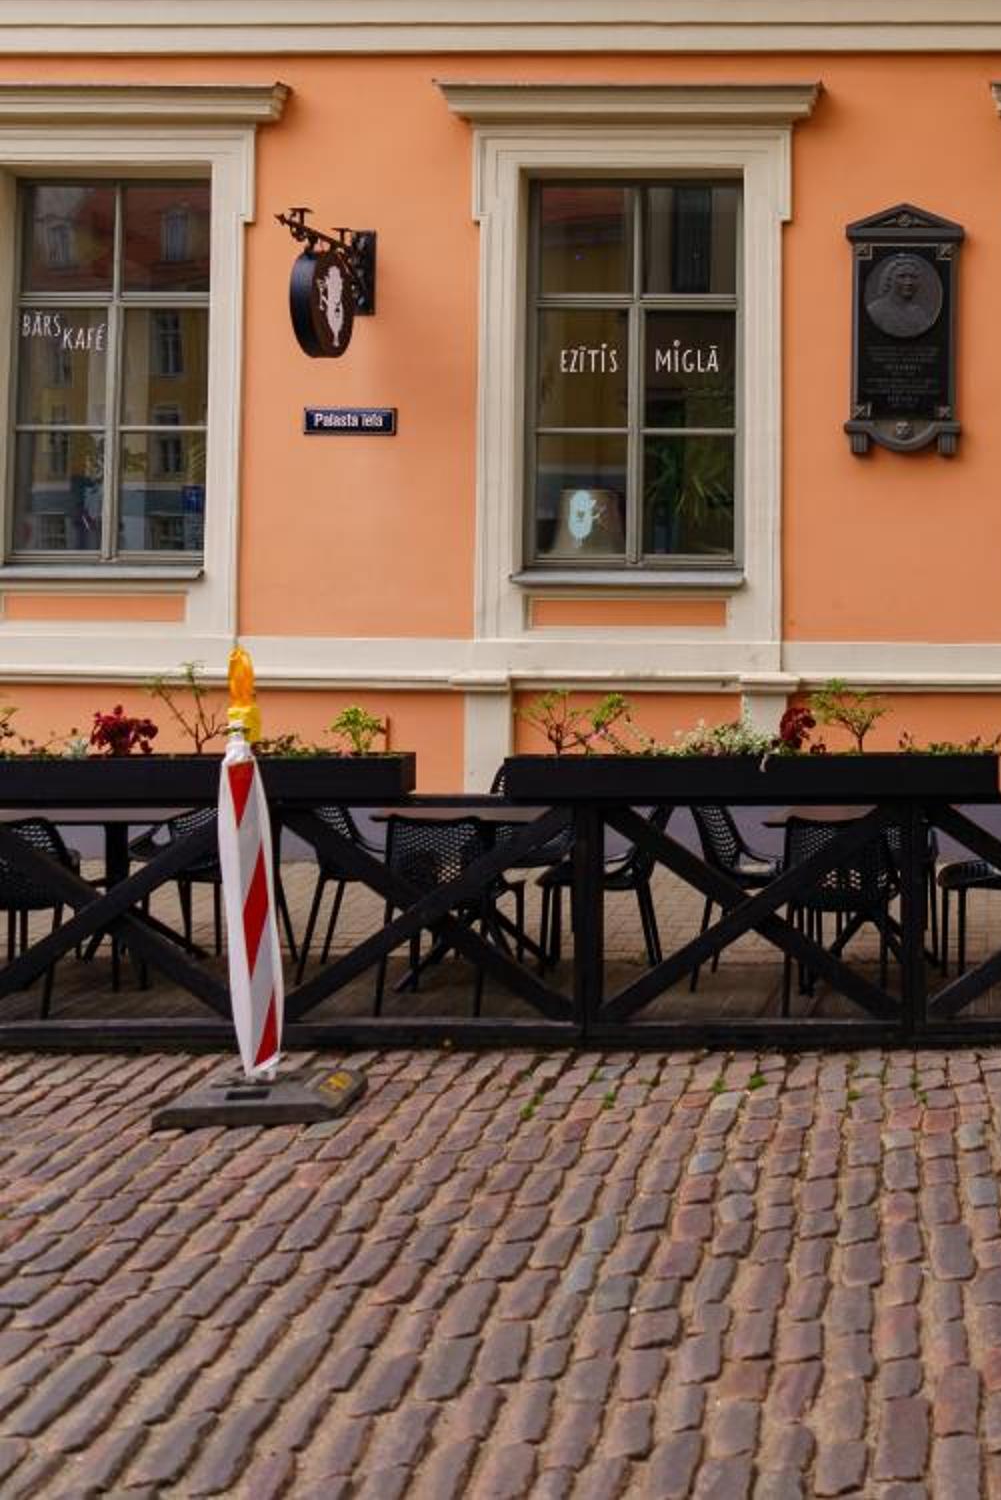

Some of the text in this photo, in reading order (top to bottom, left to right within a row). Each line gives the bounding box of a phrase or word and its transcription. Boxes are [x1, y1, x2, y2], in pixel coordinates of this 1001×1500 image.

[22, 311, 61, 337] BĀRS
[560, 339, 719, 372] EZĪTIS MIGLĀ
